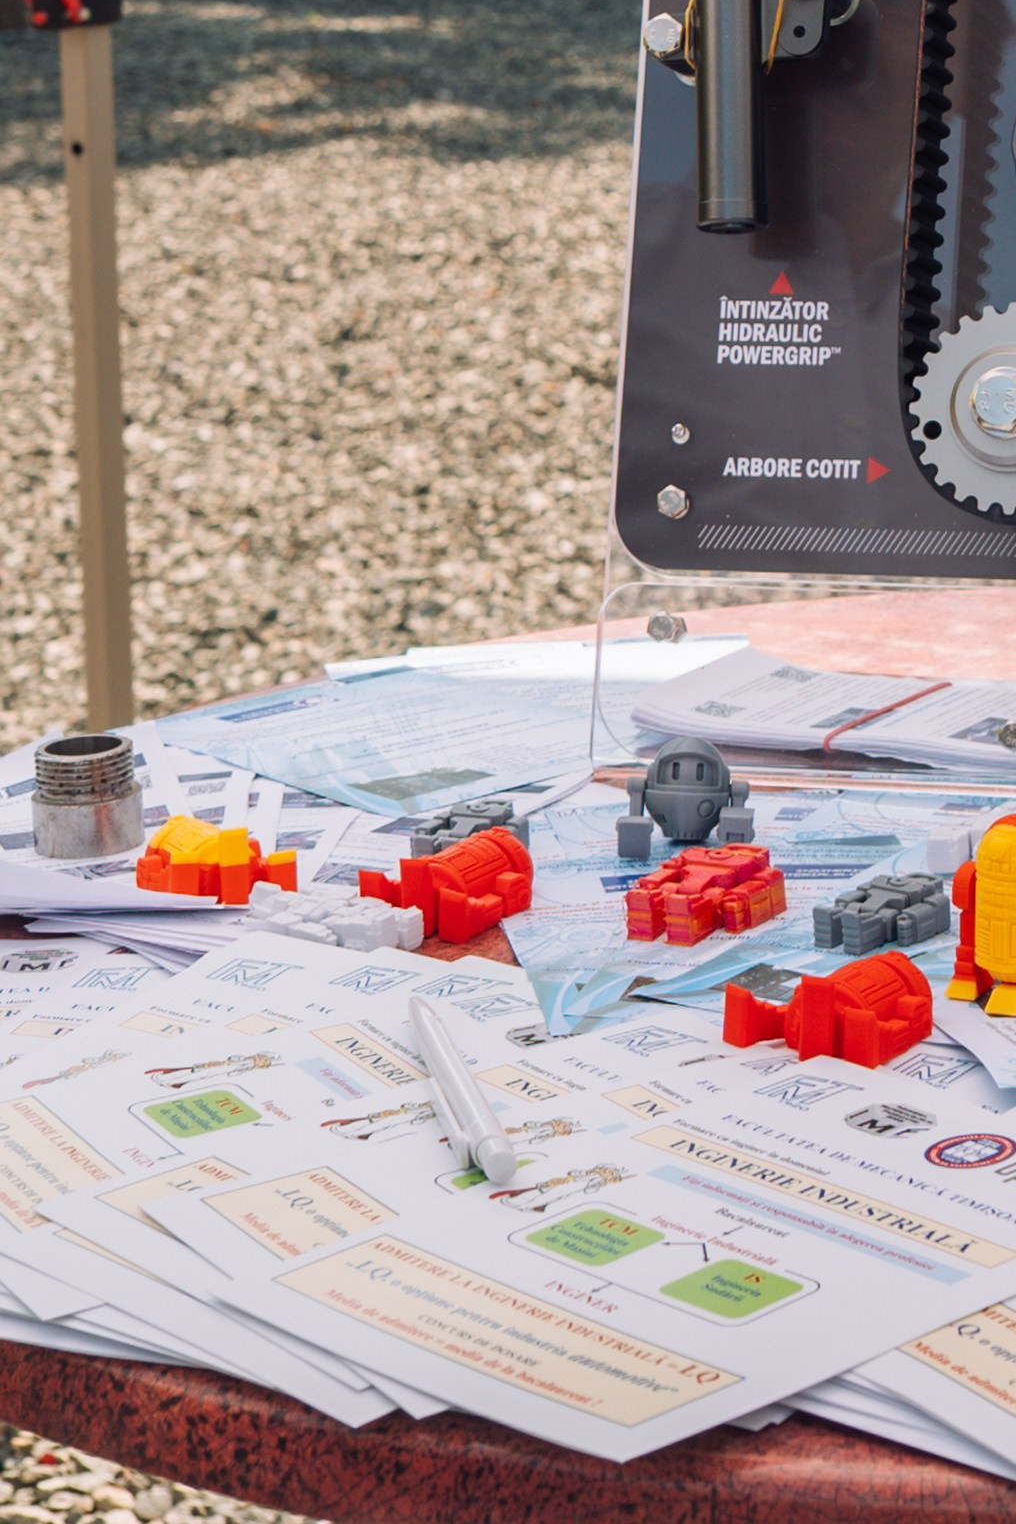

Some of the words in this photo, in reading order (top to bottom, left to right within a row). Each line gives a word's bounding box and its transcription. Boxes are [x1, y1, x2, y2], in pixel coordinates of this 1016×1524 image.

[719, 295, 830, 320] ÎNTINZĂTOR
[718, 323, 823, 343] HIDRAULIC
[722, 457, 803, 478] ARBORE
[806, 459, 862, 479] COTIT
[669, 1138, 801, 1190] INGINERIE
[799, 1183, 980, 1255] INDUSTRIALĂ
